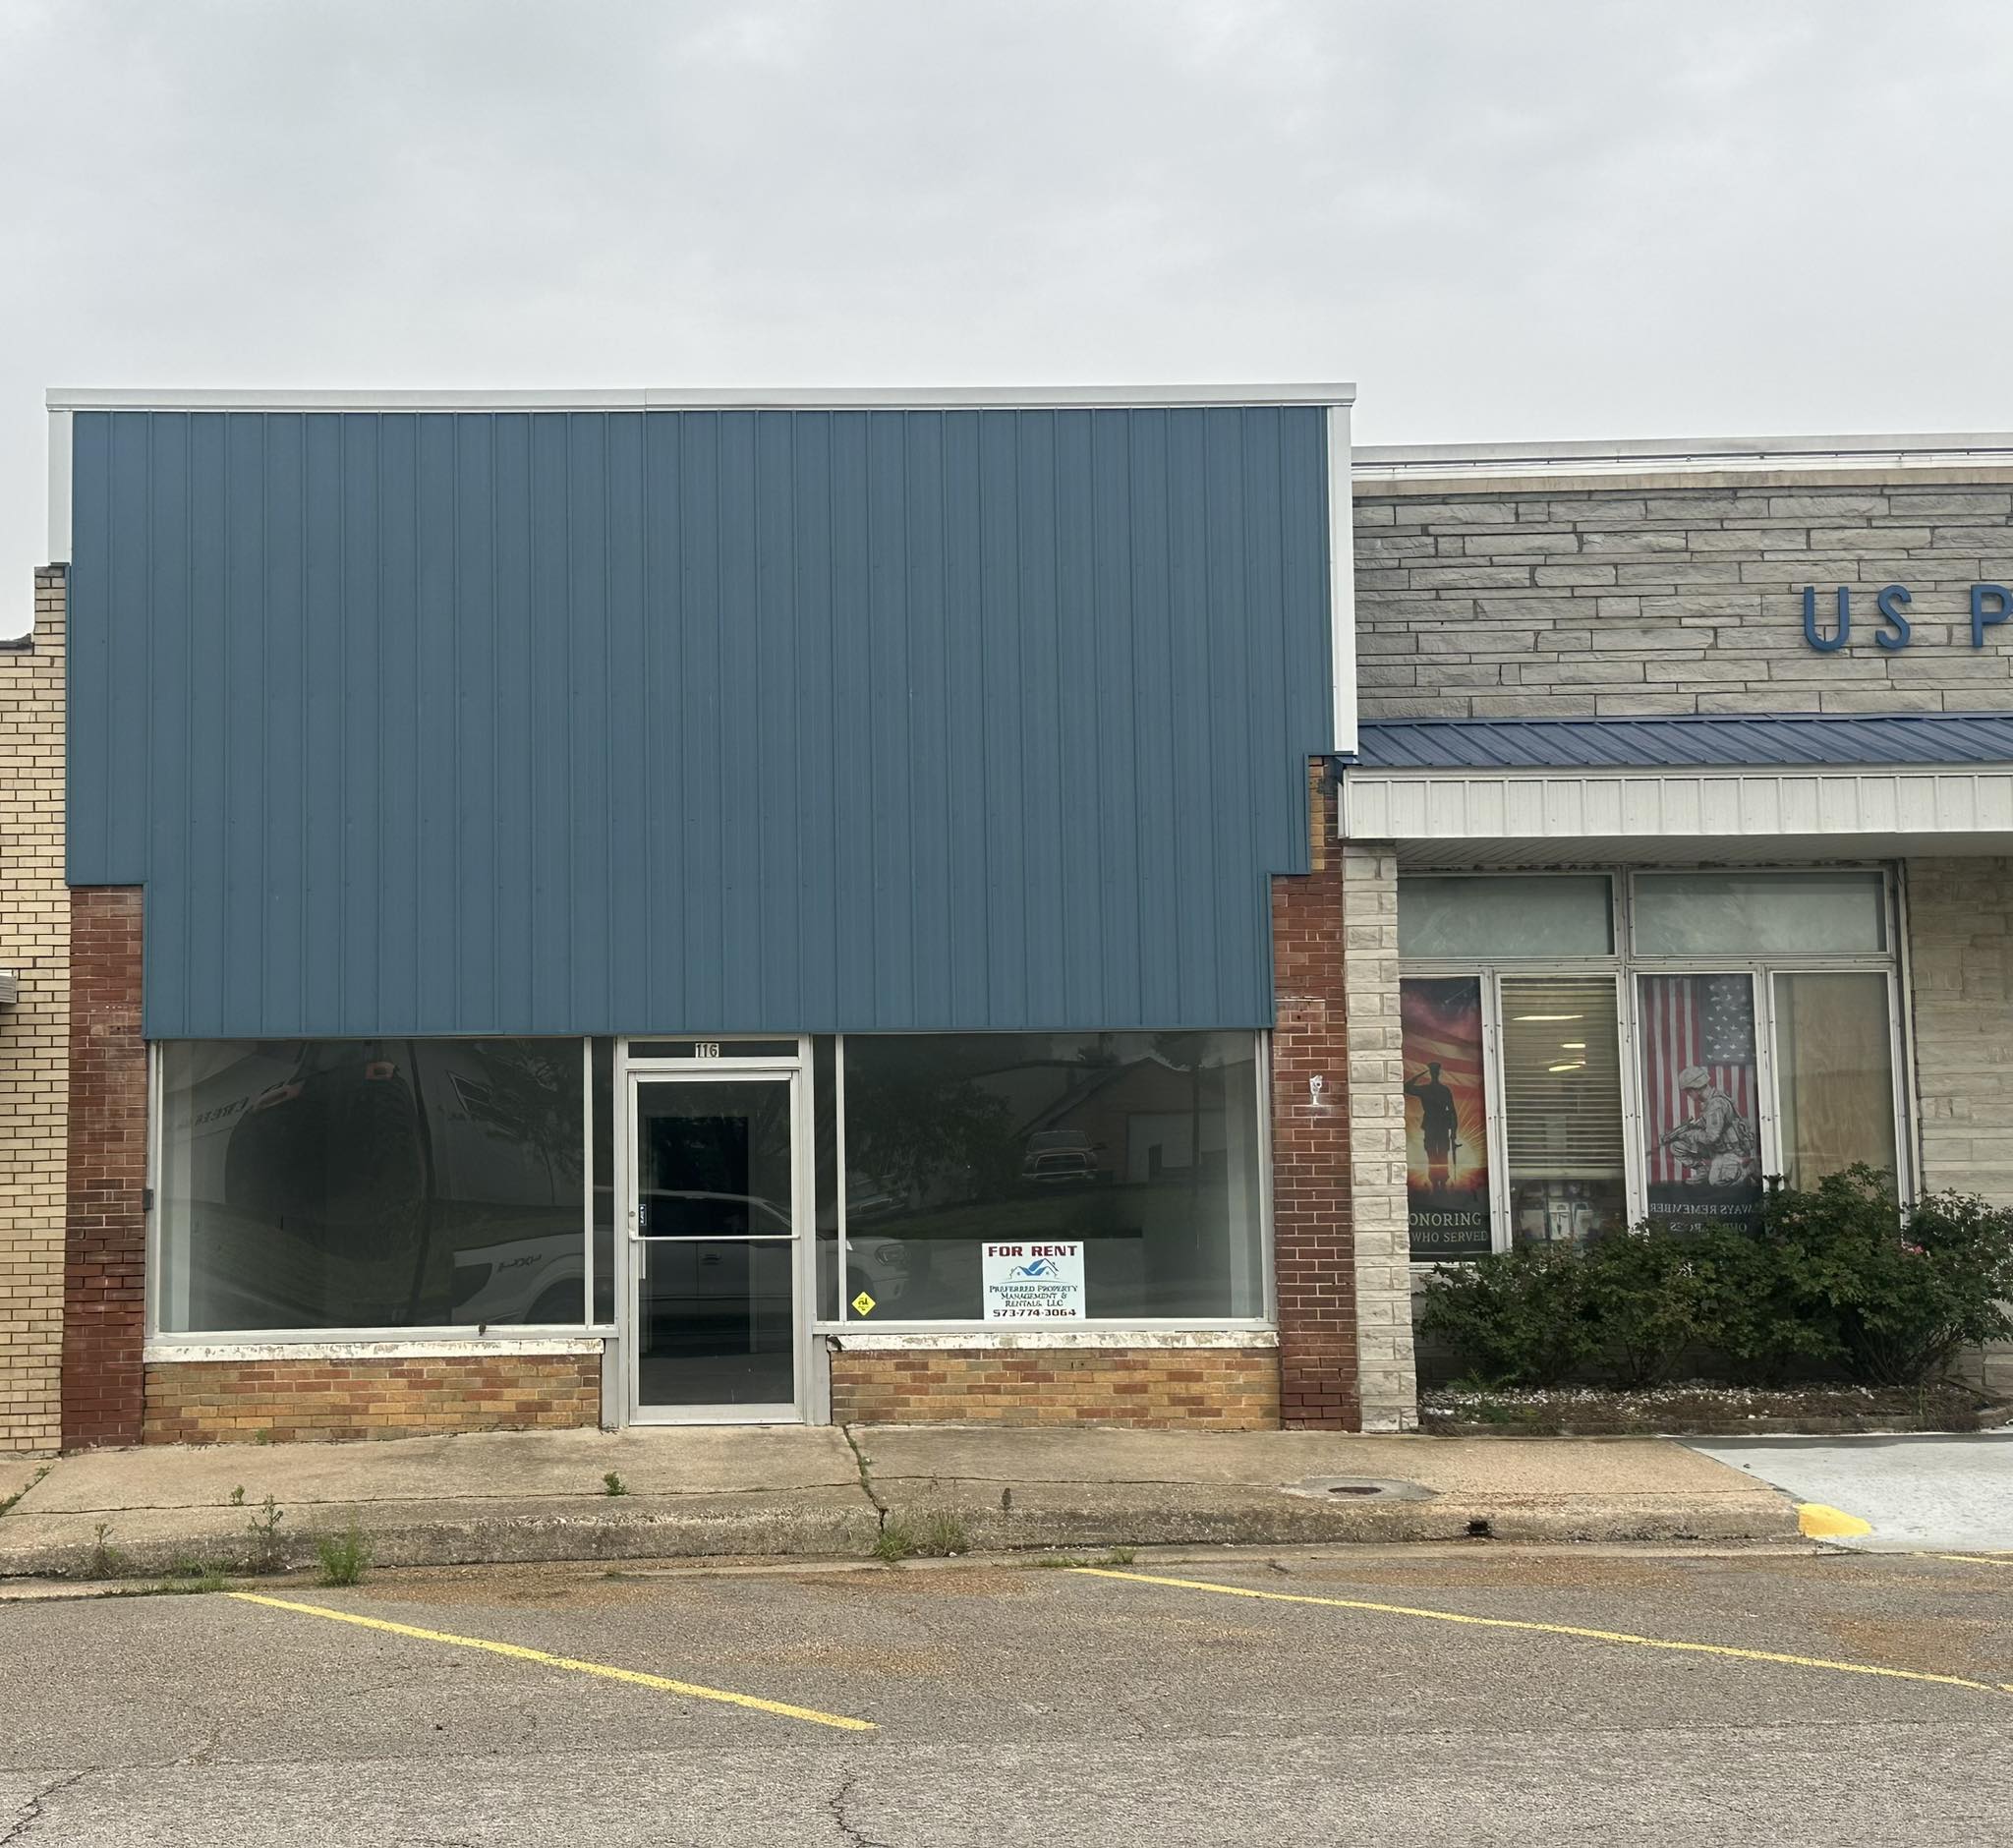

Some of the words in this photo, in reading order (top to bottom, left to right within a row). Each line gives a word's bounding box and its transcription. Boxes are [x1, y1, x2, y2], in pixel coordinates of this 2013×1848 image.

[696, 1044, 718, 1058] 116
[1409, 1212, 1481, 1227] ONORING
[1411, 1232, 1440, 1243] WHO
[1443, 1230, 1488, 1242] SERVED
[988, 1245, 1023, 1257] FOR
[1031, 1244, 1078, 1257] RENT
[1047, 1299, 1064, 1307] LLC
